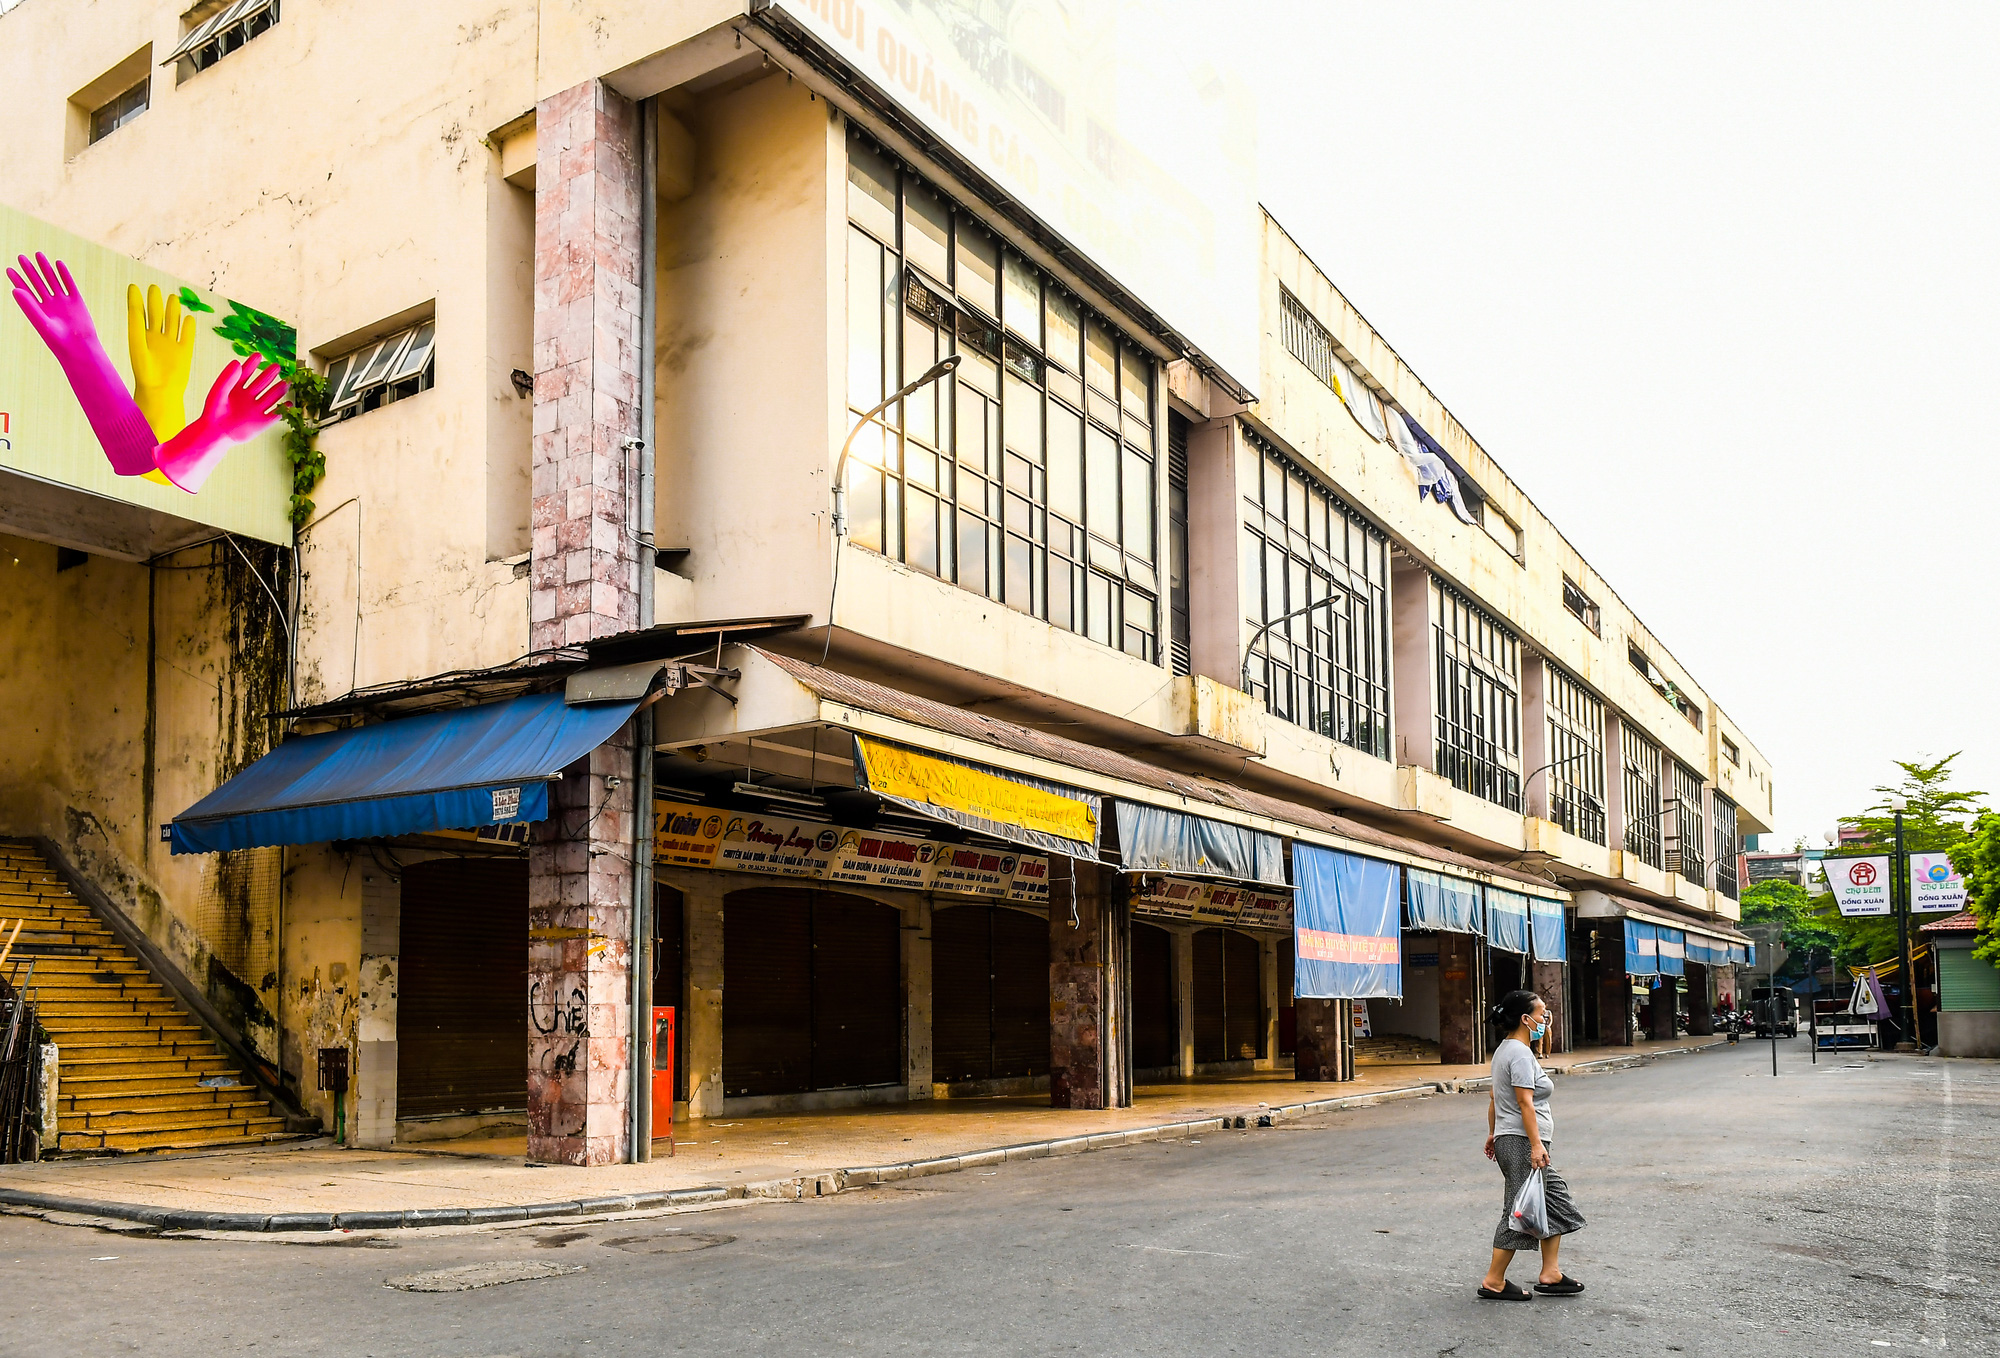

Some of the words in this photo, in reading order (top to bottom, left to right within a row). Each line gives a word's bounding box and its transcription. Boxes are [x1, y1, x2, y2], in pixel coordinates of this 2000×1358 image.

[877, 26, 979, 148] QUẢNG
[988, 123, 1039, 197] CÁO
[784, 826, 815, 856] Long
[858, 837, 882, 858] KIM
[843, 859, 855, 870] BÁN
[878, 863, 891, 874] BÁN
[1863, 897, 1885, 905] XUÂN
[1941, 893, 1963, 901] XUÂN
[1352, 939, 1376, 954] VIỆT
[1378, 941, 1398, 953] ANH
